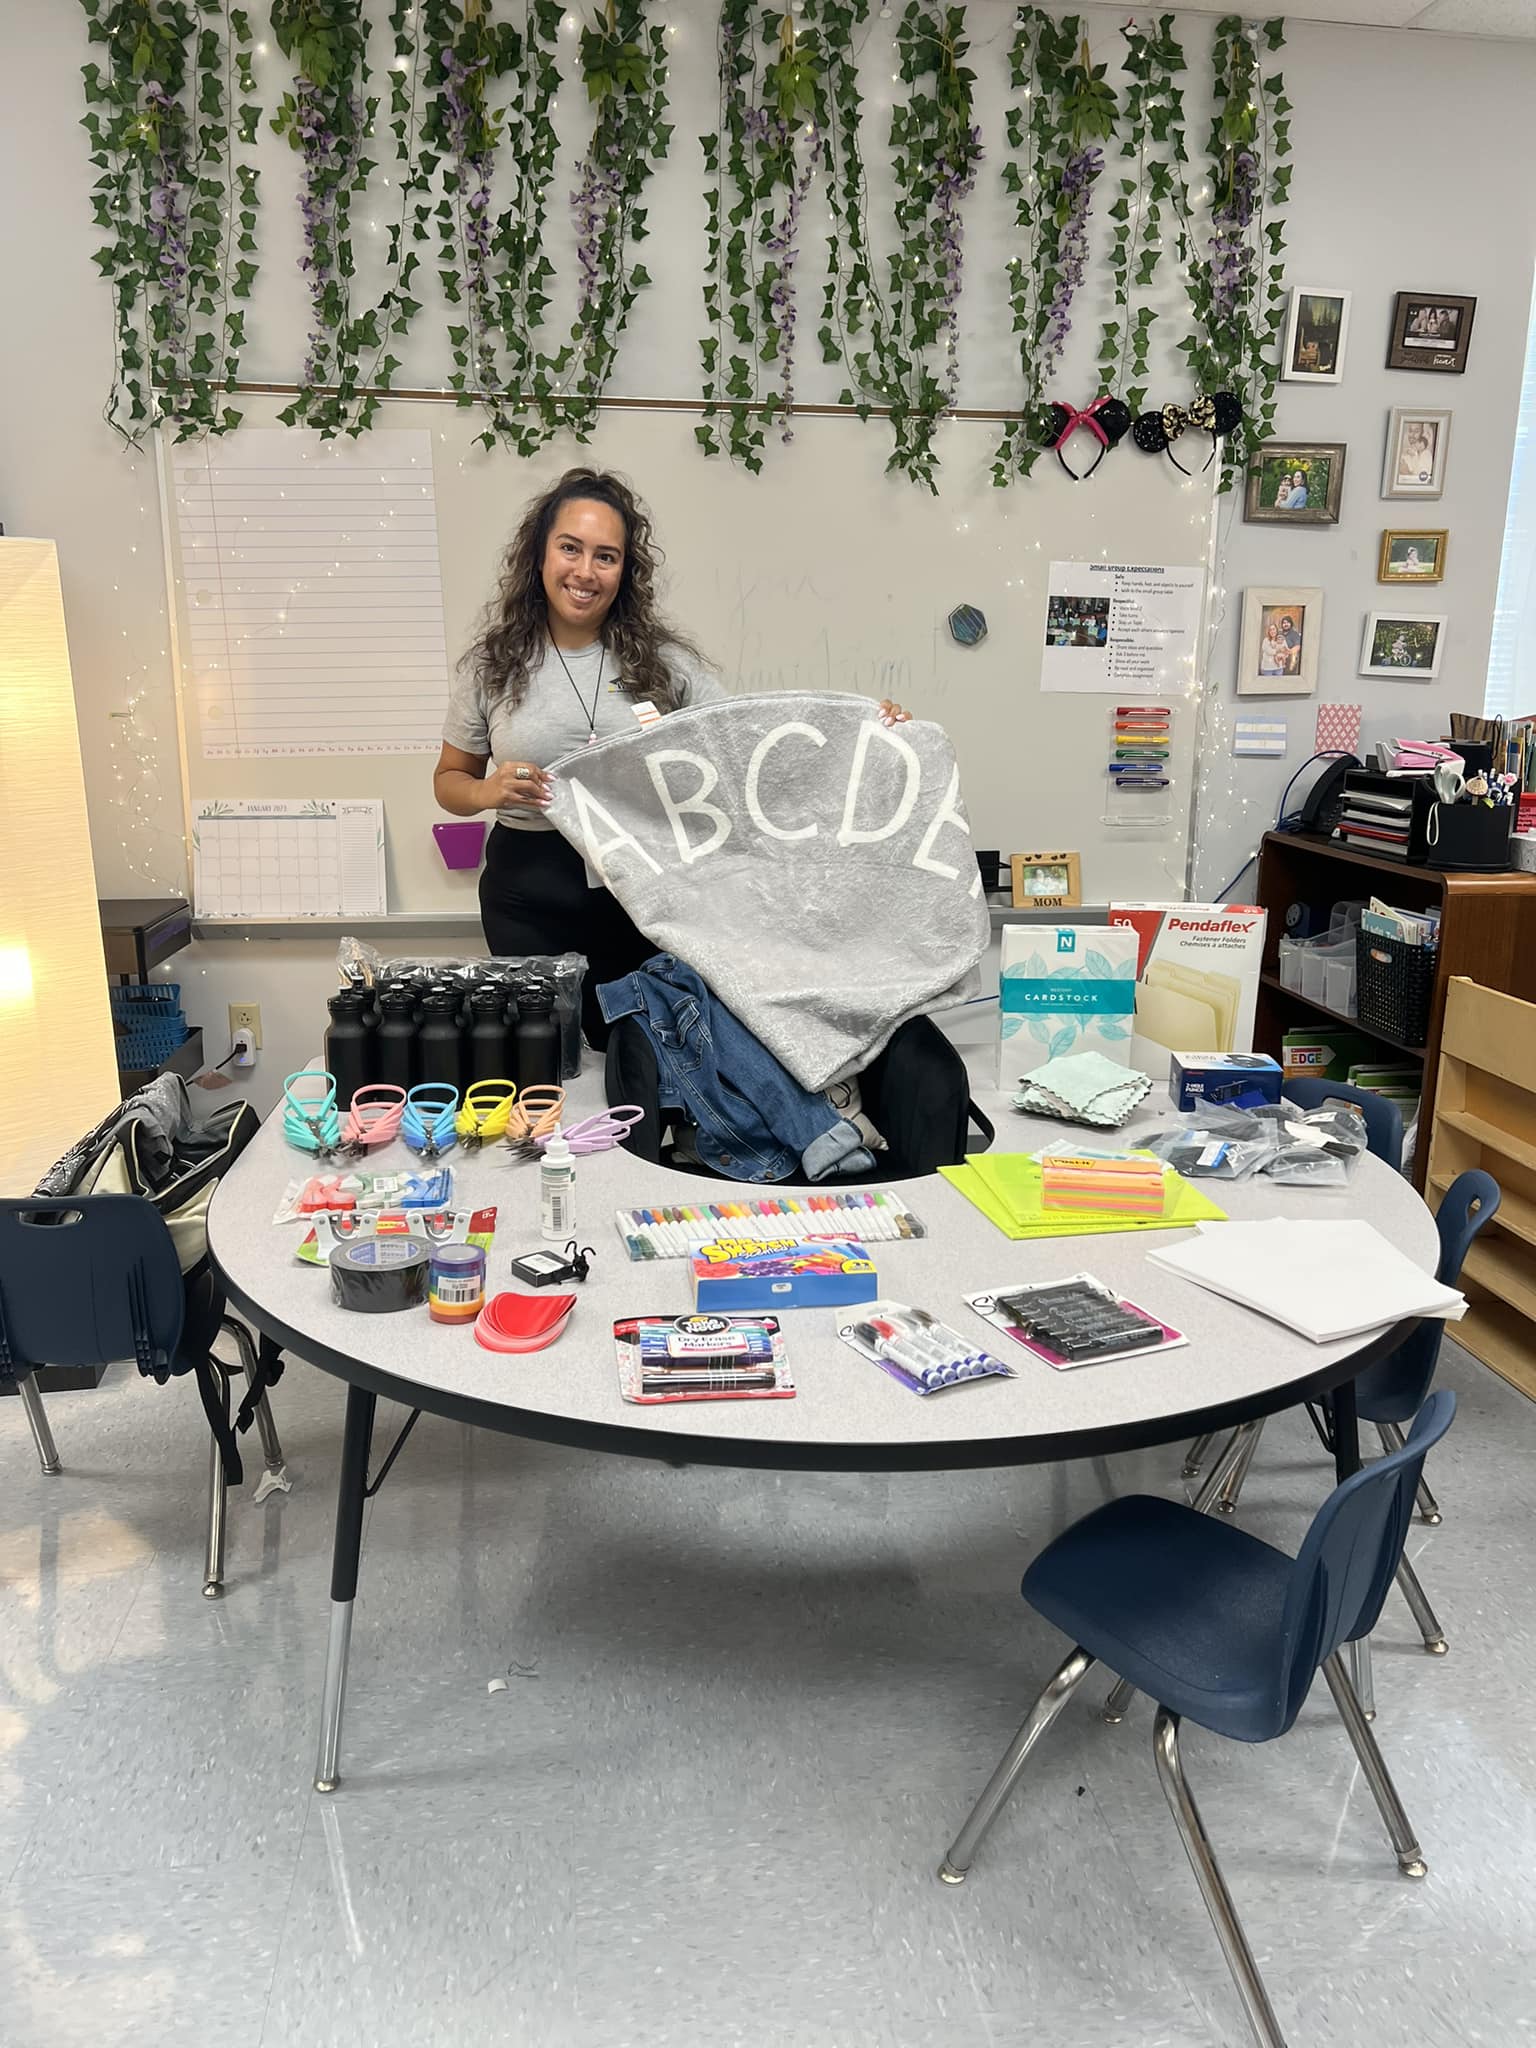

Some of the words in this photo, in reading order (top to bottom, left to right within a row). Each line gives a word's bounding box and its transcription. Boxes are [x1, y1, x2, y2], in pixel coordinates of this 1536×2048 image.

[1127, 566, 1164, 574] Expectations
[1033, 897, 1062, 907] MOM
[1167, 918, 1257, 934] Pendaflex
[1061, 936, 1073, 948] N
[1192, 935, 1220, 943] Fastener
[1222, 936, 1247, 944] Folders
[1180, 940, 1210, 948] Chemises
[1218, 941, 1246, 949] attaches
[1024, 993, 1098, 1002] CARDSTOCK
[1291, 1053, 1322, 1064] EDGE
